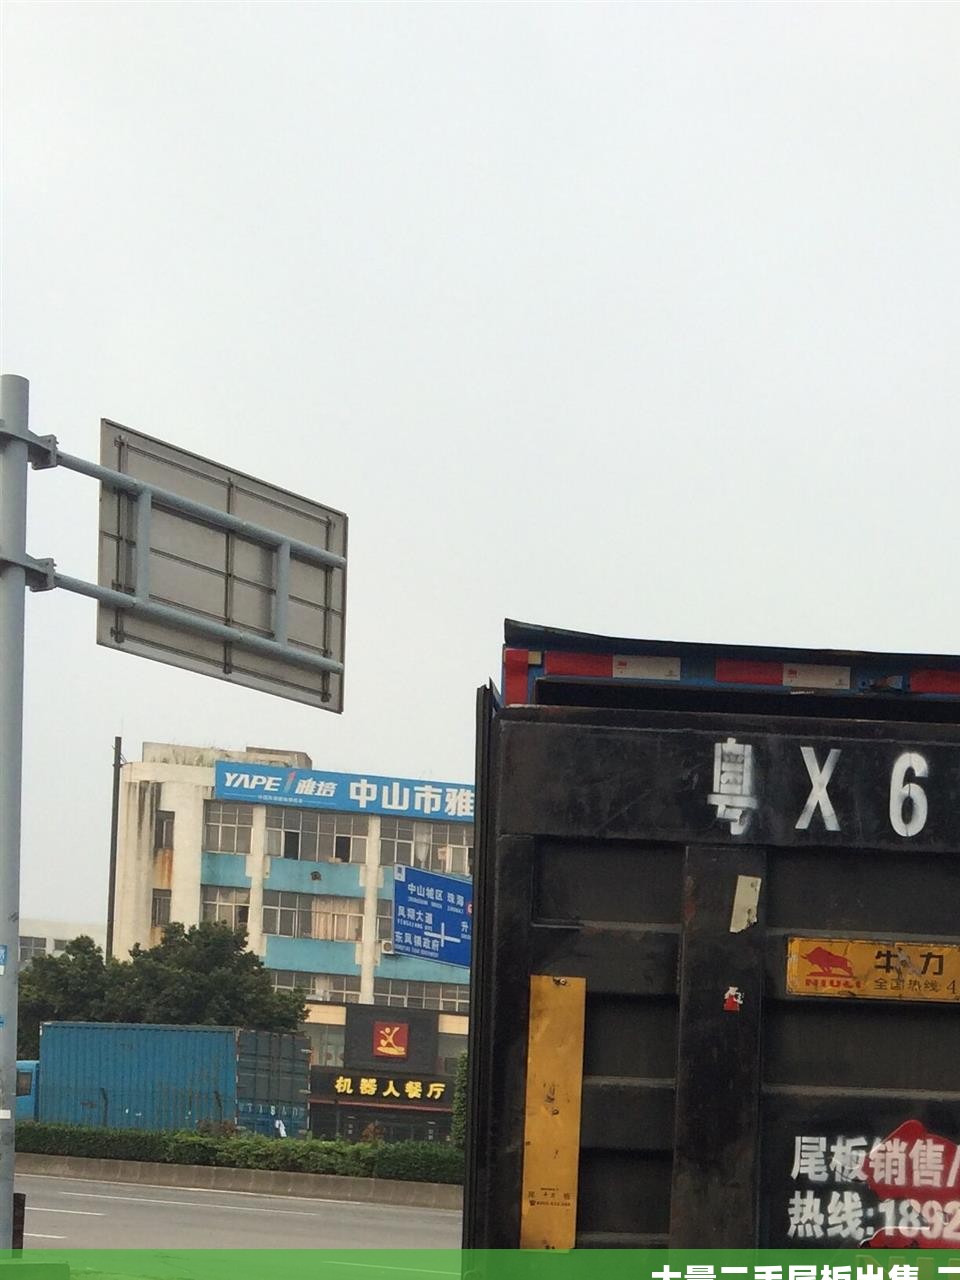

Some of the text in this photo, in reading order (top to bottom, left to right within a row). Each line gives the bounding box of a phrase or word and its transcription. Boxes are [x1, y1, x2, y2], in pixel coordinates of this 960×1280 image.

[224, 772, 282, 792] YAPE
[334, 1076, 446, 1100] 机器人餐厅
